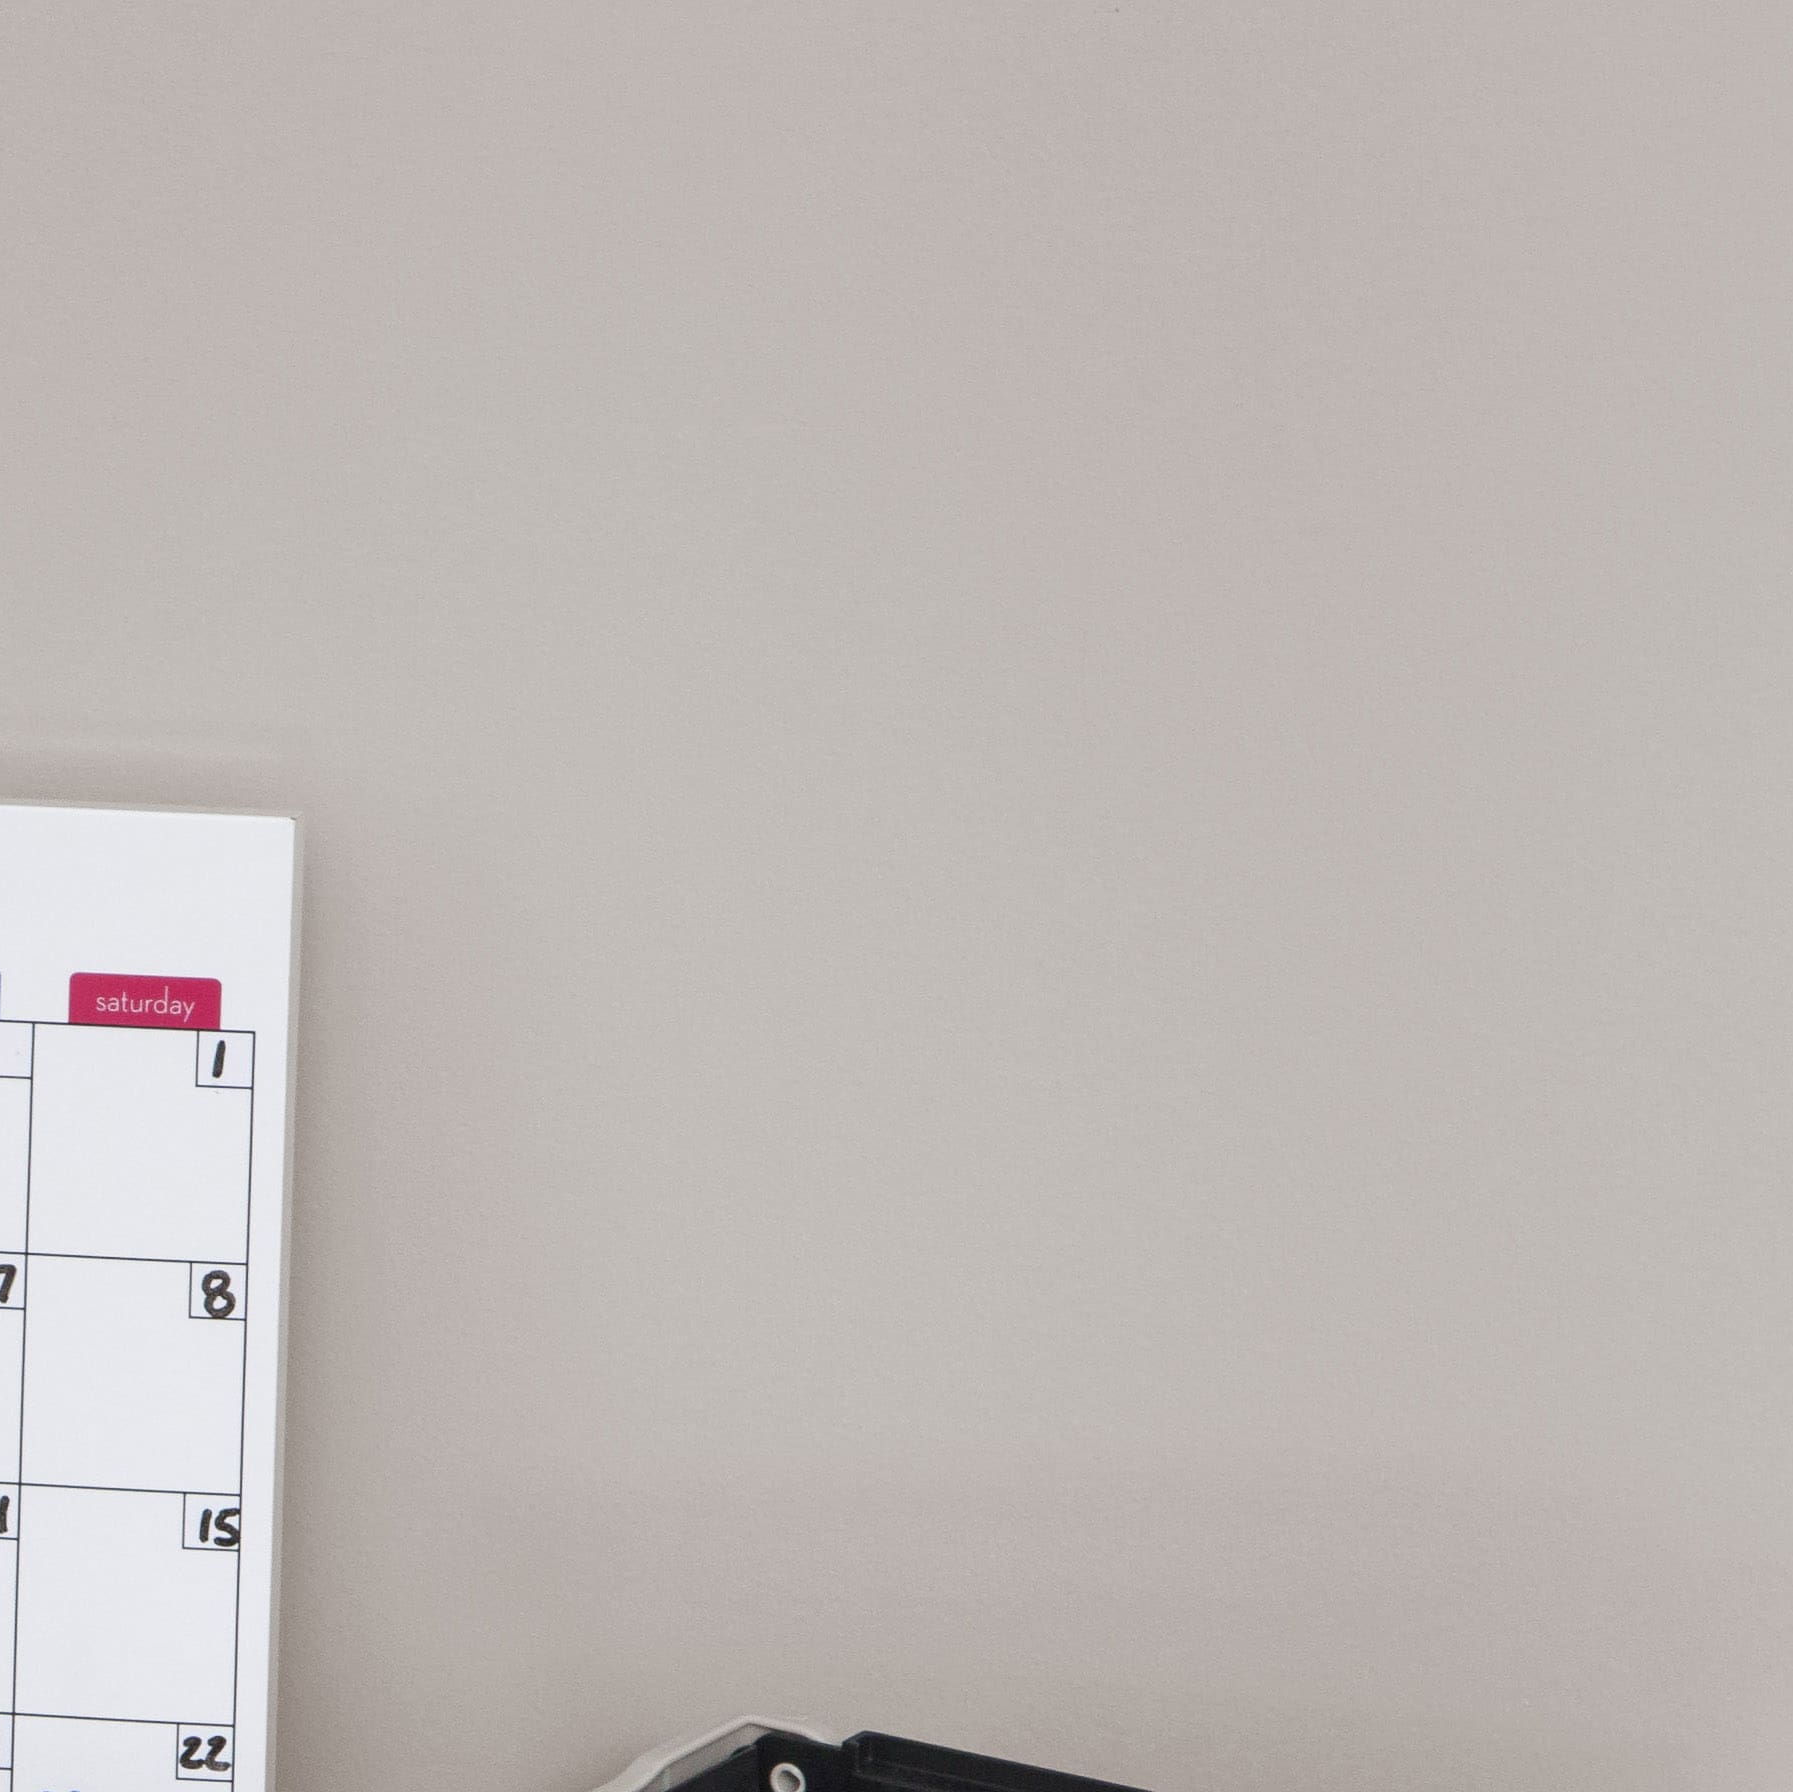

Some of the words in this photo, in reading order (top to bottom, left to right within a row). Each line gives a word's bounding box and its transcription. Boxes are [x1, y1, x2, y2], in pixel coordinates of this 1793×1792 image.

[95, 991, 195, 1020] saturday
[211, 1040, 225, 1077] 1
[202, 1271, 236, 1319] 8
[200, 1508, 240, 1547] 15
[180, 1736, 232, 1772] 22
